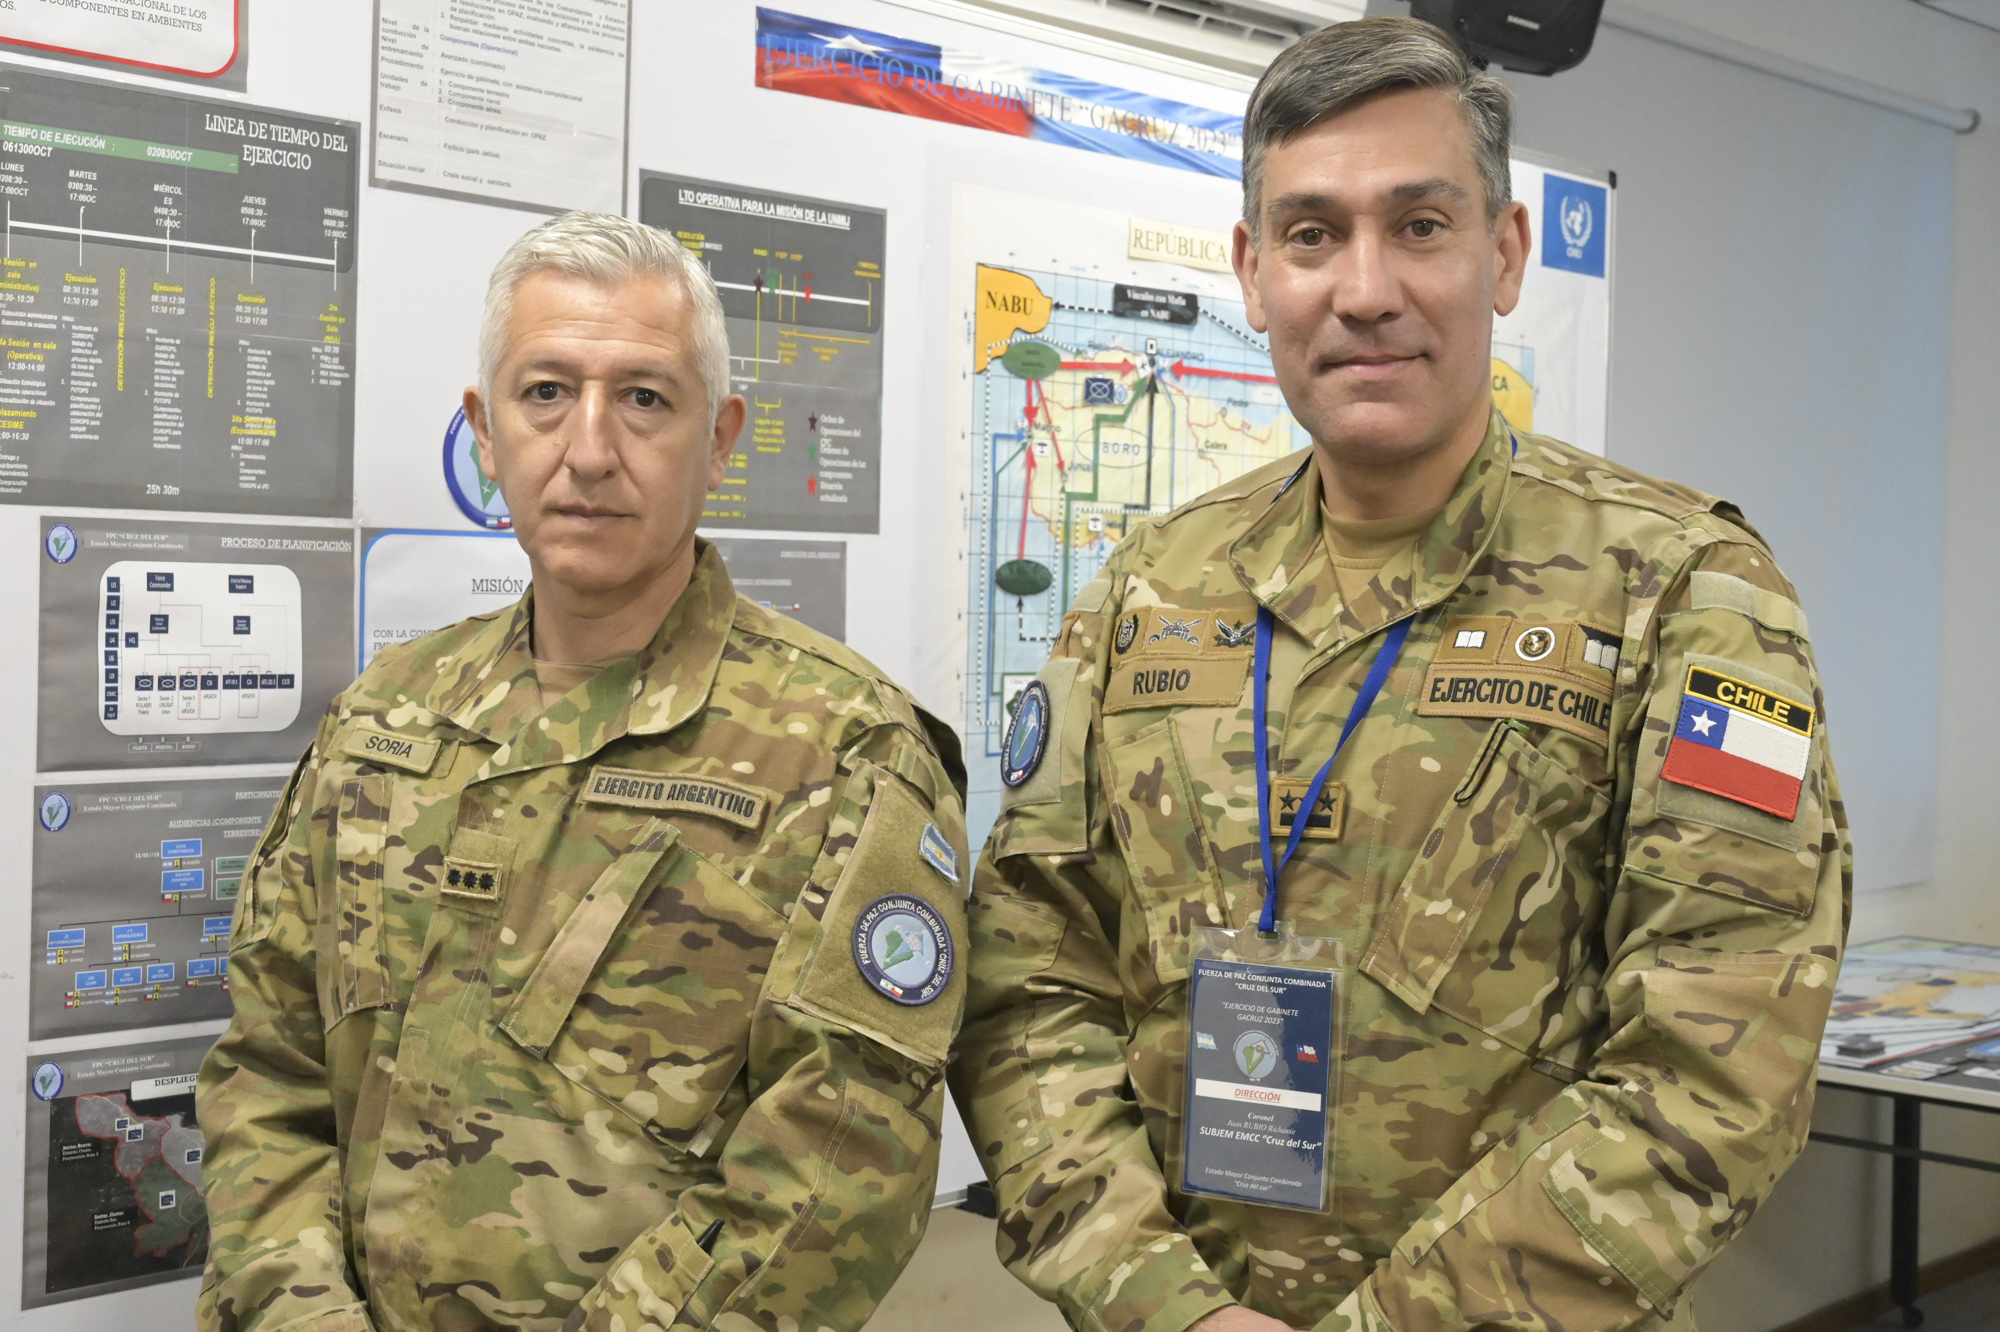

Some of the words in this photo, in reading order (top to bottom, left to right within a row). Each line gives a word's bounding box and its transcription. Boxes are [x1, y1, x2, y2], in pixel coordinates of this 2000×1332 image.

[189, 8, 207, 19] LOS
[131, 10, 145, 20] EN
[148, 13, 202, 32] AMBIENTES
[382, 17, 397, 26] Nivel
[381, 27, 416, 39] conducción
[381, 35, 397, 44] Nivel
[440, 34, 479, 48] Componentes
[381, 45, 423, 58] entrenamiento
[381, 55, 423, 70] Procedimiento
[380, 72, 408, 84] Unidades
[765, 32, 905, 88] EJERCICIO
[913, 63, 947, 96] DE
[953, 72, 1072, 123] GABINETE
[380, 81, 401, 92] trabajo
[445, 116, 479, 128] Conducción
[3, 124, 38, 140] TIEMPO
[40, 130, 53, 142] DE
[54, 133, 106, 150] EJECUCIÓN
[205, 113, 246, 136] LINEA
[248, 120, 267, 140] DE
[270, 123, 320, 148] TIEMPO
[322, 132, 348, 152] DEL
[379, 131, 408, 143] Escenario
[242, 144, 312, 171] EJERCICIO
[0, 162, 24, 172] LUNES
[378, 160, 405, 170] Situación
[407, 164, 425, 173] inicial
[69, 169, 98, 181] MARTES
[443, 170, 459, 180] Crisis
[461, 173, 478, 182] social
[242, 195, 267, 206] JUEVES
[323, 207, 349, 218] VIERNES
[696, 192, 740, 211] OPERATIVA
[741, 199, 764, 214] PARA
[764, 203, 775, 215] LA
[776, 204, 803, 220] MISIÓN
[804, 208, 815, 221] DE
[816, 210, 827, 223] LA
[1133, 227, 1228, 264] REPÚBLICA
[65, 272, 97, 284] Ejecución
[153, 281, 184, 294] Ejecución
[985, 290, 1034, 316] NABU
[1149, 308, 1171, 321] NABU
[1102, 441, 1141, 456] BORO
[146, 483, 161, 495] 25h
[162, 484, 180, 496] 30m
[221, 537, 266, 548] PROCESO
[268, 539, 281, 549] DE
[282, 539, 352, 551] PLANIFICACIÓN
[471, 575, 524, 593] MISIÓN
[373, 629, 394, 638] CON
[396, 629, 407, 638] LA
[1132, 668, 1191, 696] RUBIO
[1429, 677, 1525, 705] EJERCITO
[1525, 681, 1558, 712] DE
[1558, 688, 1612, 732] CHILE
[1716, 681, 1791, 723] CHILE
[365, 735, 414, 759] SORIA
[593, 776, 665, 801] EJERCITO
[666, 783, 756, 818] ARGENTINO
[169, 819, 211, 828] AUDIENCIAS
[877, 899, 916, 912] CONJUNTA
[866, 907, 879, 924] PAZ
[860, 919, 871, 932] DE
[916, 905, 947, 949] COMBINADA
[858, 934, 871, 965] FUERZA
[931, 972, 943, 988] DEL
[1198, 968, 1223, 978] FUERZA
[1224, 971, 1233, 979] DE
[1234, 972, 1247, 980] PAZ
[1247, 973, 1283, 984] CONJUNTA
[1283, 977, 1326, 988] COMBINADA
[1256, 985, 1269, 993] DEL
[1256, 1005, 1266, 1013] DE
[1266, 1006, 1299, 1017] GABINETE
[1237, 1013, 1263, 1023] GACRUZ
[1234, 1088, 1282, 1102] DIRECCIÓN
[1247, 1112, 1275, 1122] Coronel
[1226, 1119, 1242, 1128] Juan
[1243, 1121, 1267, 1131] RUBIO
[1199, 1126, 1234, 1139] SUBJEM
[1235, 1132, 1260, 1142] EMCC
[1287, 1138, 1300, 1148] del
[1205, 1166, 1224, 1177] Estado
[1224, 1169, 1243, 1179] Mayor
[1243, 1172, 1269, 1183] Conjunto
[1270, 1176, 1303, 1188] Combinado
[1249, 1182, 1259, 1190] del
